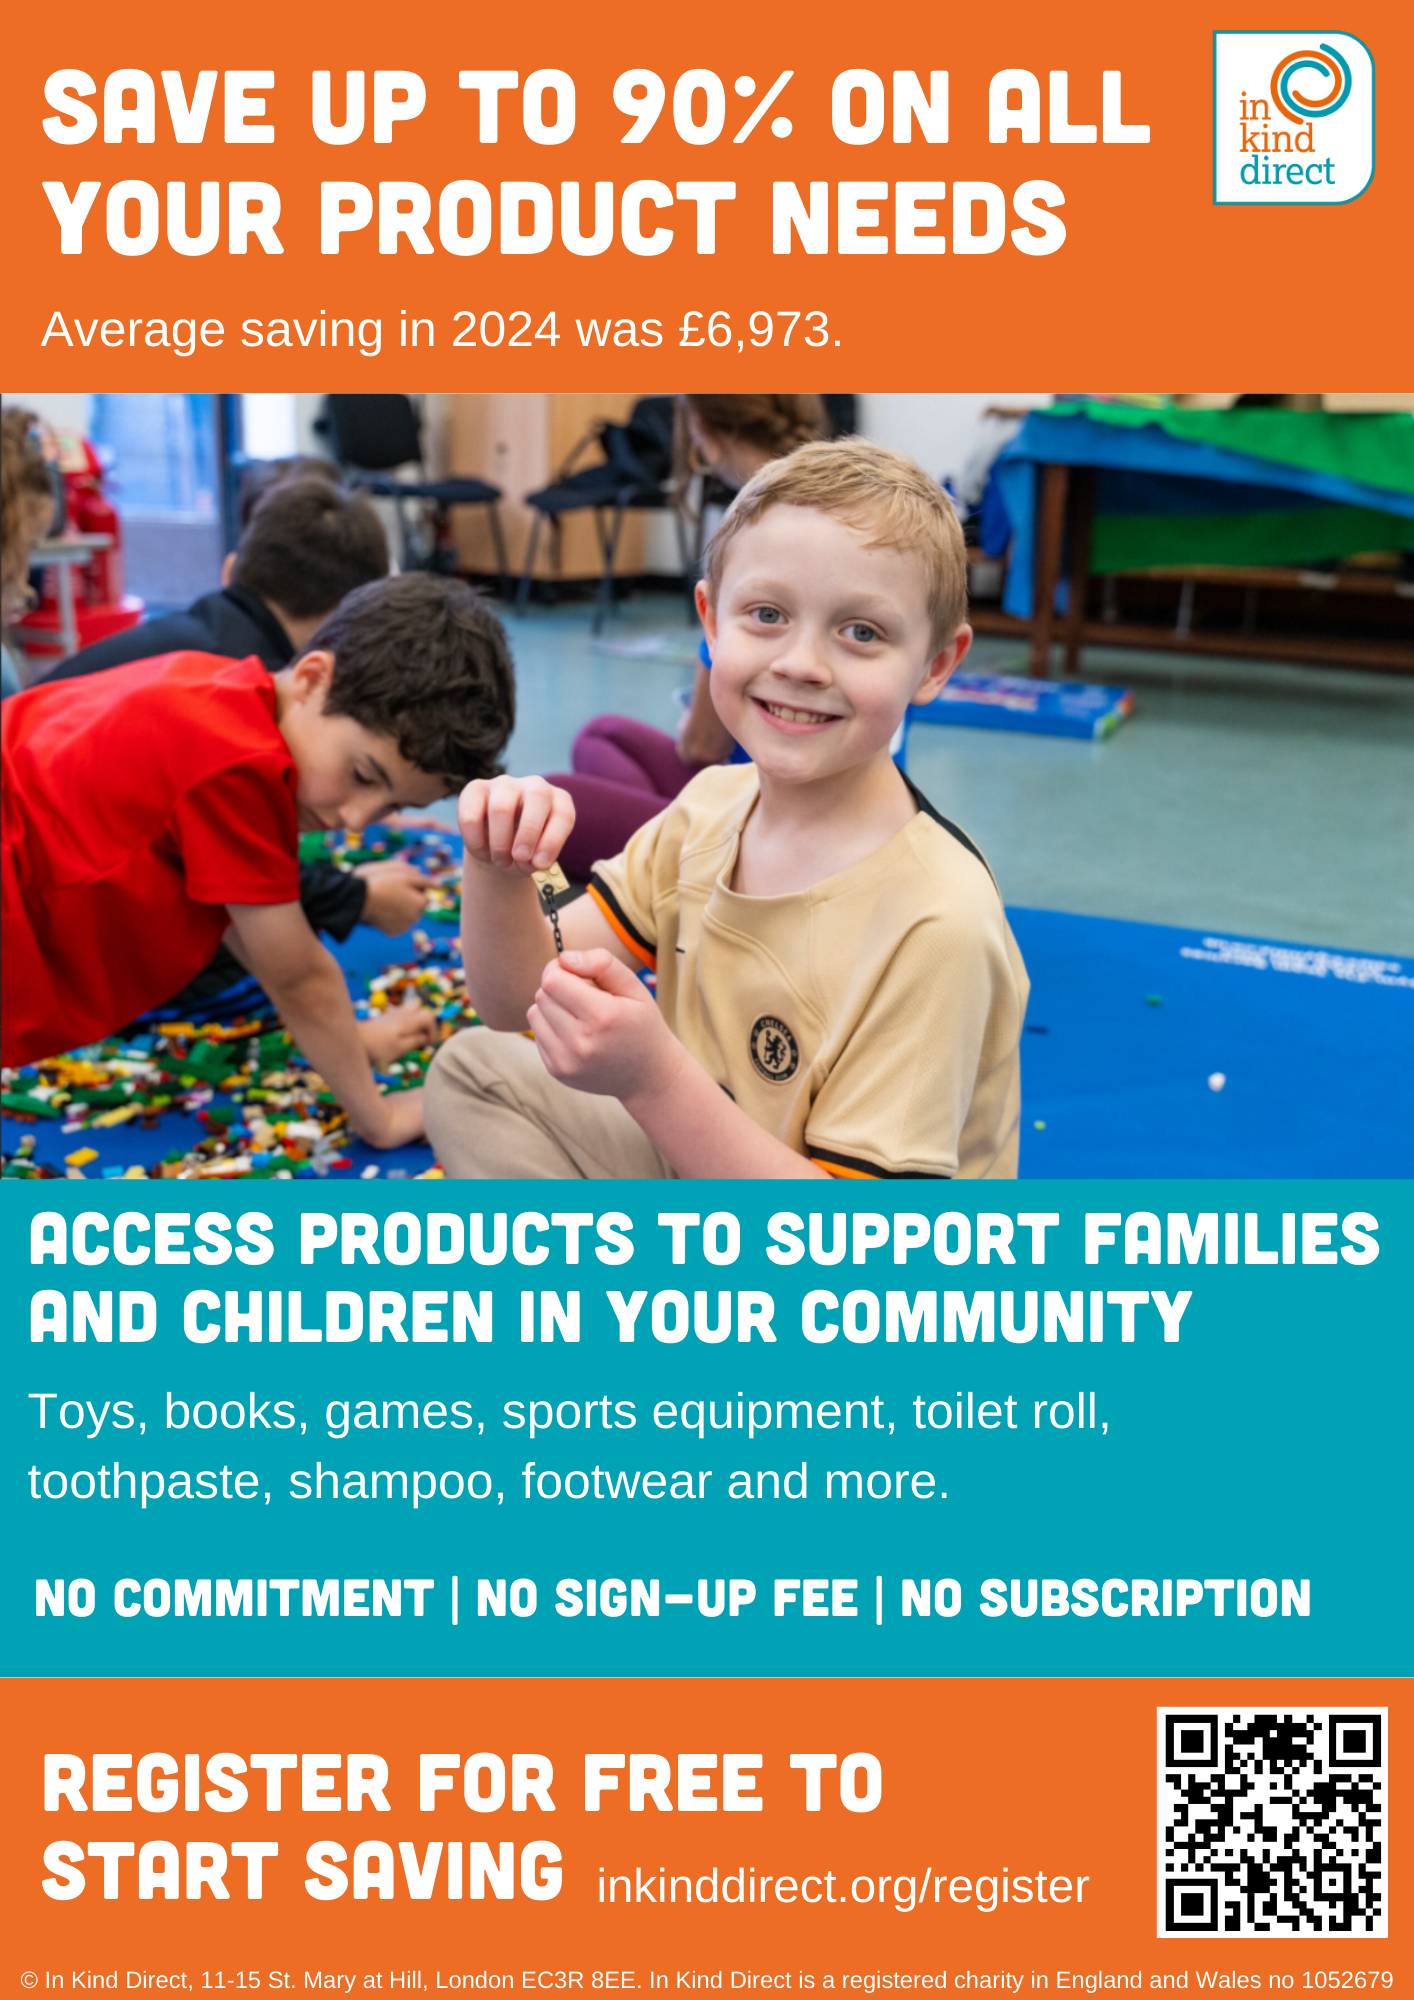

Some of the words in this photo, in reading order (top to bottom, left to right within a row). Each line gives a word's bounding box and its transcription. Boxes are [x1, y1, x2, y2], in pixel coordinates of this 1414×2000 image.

[42, 69, 274, 145] SAVE
[312, 70, 426, 145] UP
[459, 69, 575, 145] TO
[613, 69, 794, 145] 90%
[832, 69, 949, 145] ON
[989, 69, 1150, 143] ALL
[1239, 91, 1271, 120] in
[1239, 122, 1316, 153] kind
[1240, 154, 1335, 185] direct
[42, 180, 284, 256] YOUR
[321, 180, 736, 256] PRODUCT
[773, 180, 1066, 256] NEEDS
[41, 312, 224, 357] Average
[241, 310, 381, 357] saving
[401, 310, 434, 346] in
[453, 311, 560, 347] 2024
[575, 319, 663, 347] was
[679, 311, 840, 353] £6,973.
[31, 1212, 274, 1266] ACCESS
[301, 1212, 634, 1266] PRODUCTS
[658, 1212, 740, 1266] TO
[766, 1212, 1059, 1266] SUPPORT
[1085, 1212, 1379, 1265] FAMILIES
[31, 1290, 156, 1342] AND
[184, 1290, 492, 1344] CHILDREN
[521, 1291, 580, 1342] IN
[606, 1290, 777, 1344] YOUR
[802, 1290, 1193, 1344] COMMUNITY
[28, 1393, 145, 1439] Toys,
[167, 1392, 306, 1435] books,
[326, 1401, 484, 1439] games,
[503, 1396, 636, 1439] sports
[653, 1392, 894, 1439] equipment,
[913, 1392, 1017, 1429] toilet
[1035, 1392, 1108, 1435] roll,
[28, 1462, 270, 1509] toothpaste,
[290, 1462, 503, 1509] shampoo,
[522, 1462, 712, 1499] footwear
[728, 1462, 807, 1499] and
[827, 1471, 947, 1499] more.
[36, 1578, 95, 1617] NO
[114, 1578, 434, 1617] COMMITMENT
[478, 1578, 537, 1617] NO
[555, 1578, 756, 1617] SIGN-UP
[774, 1579, 858, 1616] FEE
[902, 1578, 961, 1617] NO
[980, 1578, 1310, 1617] SUBSCRIPTION
[44, 1752, 391, 1813] REGISTER
[420, 1752, 556, 1813] FOR
[585, 1754, 763, 1811] FREE
[790, 1752, 882, 1813] TO
[42, 1840, 278, 1900] START
[305, 1840, 562, 1901] SAVING
[599, 1867, 1089, 1912] inkinddirect.org/register
[47, 1971, 63, 1988] In
[73, 1971, 117, 1988] Kind
[127, 1971, 192, 1991] Direct,
[202, 1971, 260, 1988] 11-15
[269, 1971, 295, 1988] St.
[305, 1971, 356, 1993] Mary
[364, 1973, 383, 1988] at
[391, 1971, 427, 1991] Hill,
[437, 1971, 513, 1988] London
[523, 1971, 583, 1988] EC3R
[592, 1971, 641, 1988] 8EE.
[651, 1971, 668, 1988] In
[677, 1971, 722, 1988] Kind
[732, 1971, 792, 1988] Direct
[800, 1971, 815, 1988] is
[823, 1975, 835, 1988] a
[843, 1971, 946, 1993] registered
[955, 1971, 1024, 1993] charity
[1032, 1971, 1048, 1988] in
[1057, 1971, 1141, 1993] England
[1150, 1971, 1188, 1988] and
[1196, 1971, 1261, 1988] Wales
[1270, 1975, 1294, 1988] no
[1303, 1971, 1393, 1988] 1052679
